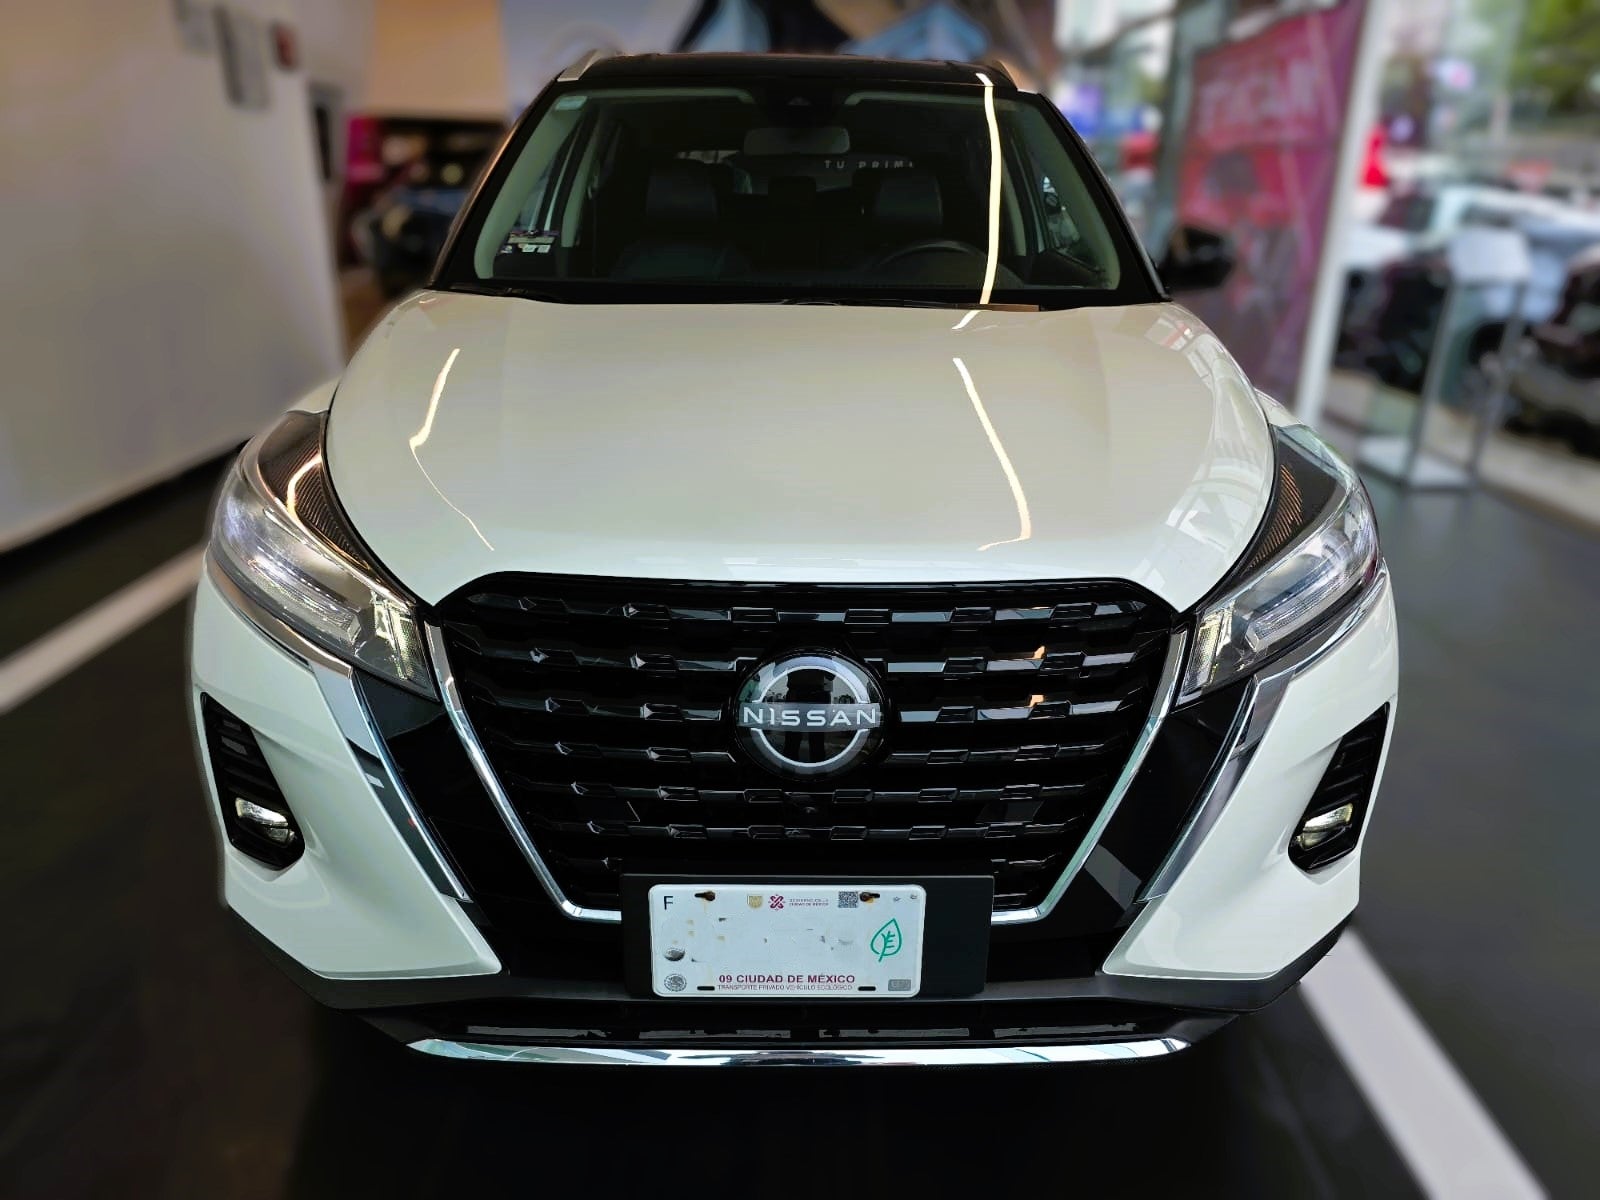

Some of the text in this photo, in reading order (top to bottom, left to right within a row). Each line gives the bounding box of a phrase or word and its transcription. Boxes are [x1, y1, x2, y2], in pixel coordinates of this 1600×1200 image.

[824, 160, 845, 168] TU
[743, 707, 876, 726] NISSAN
[663, 896, 674, 910] F
[719, 973, 855, 983] 09 CIUDAD DE MÉXICO
